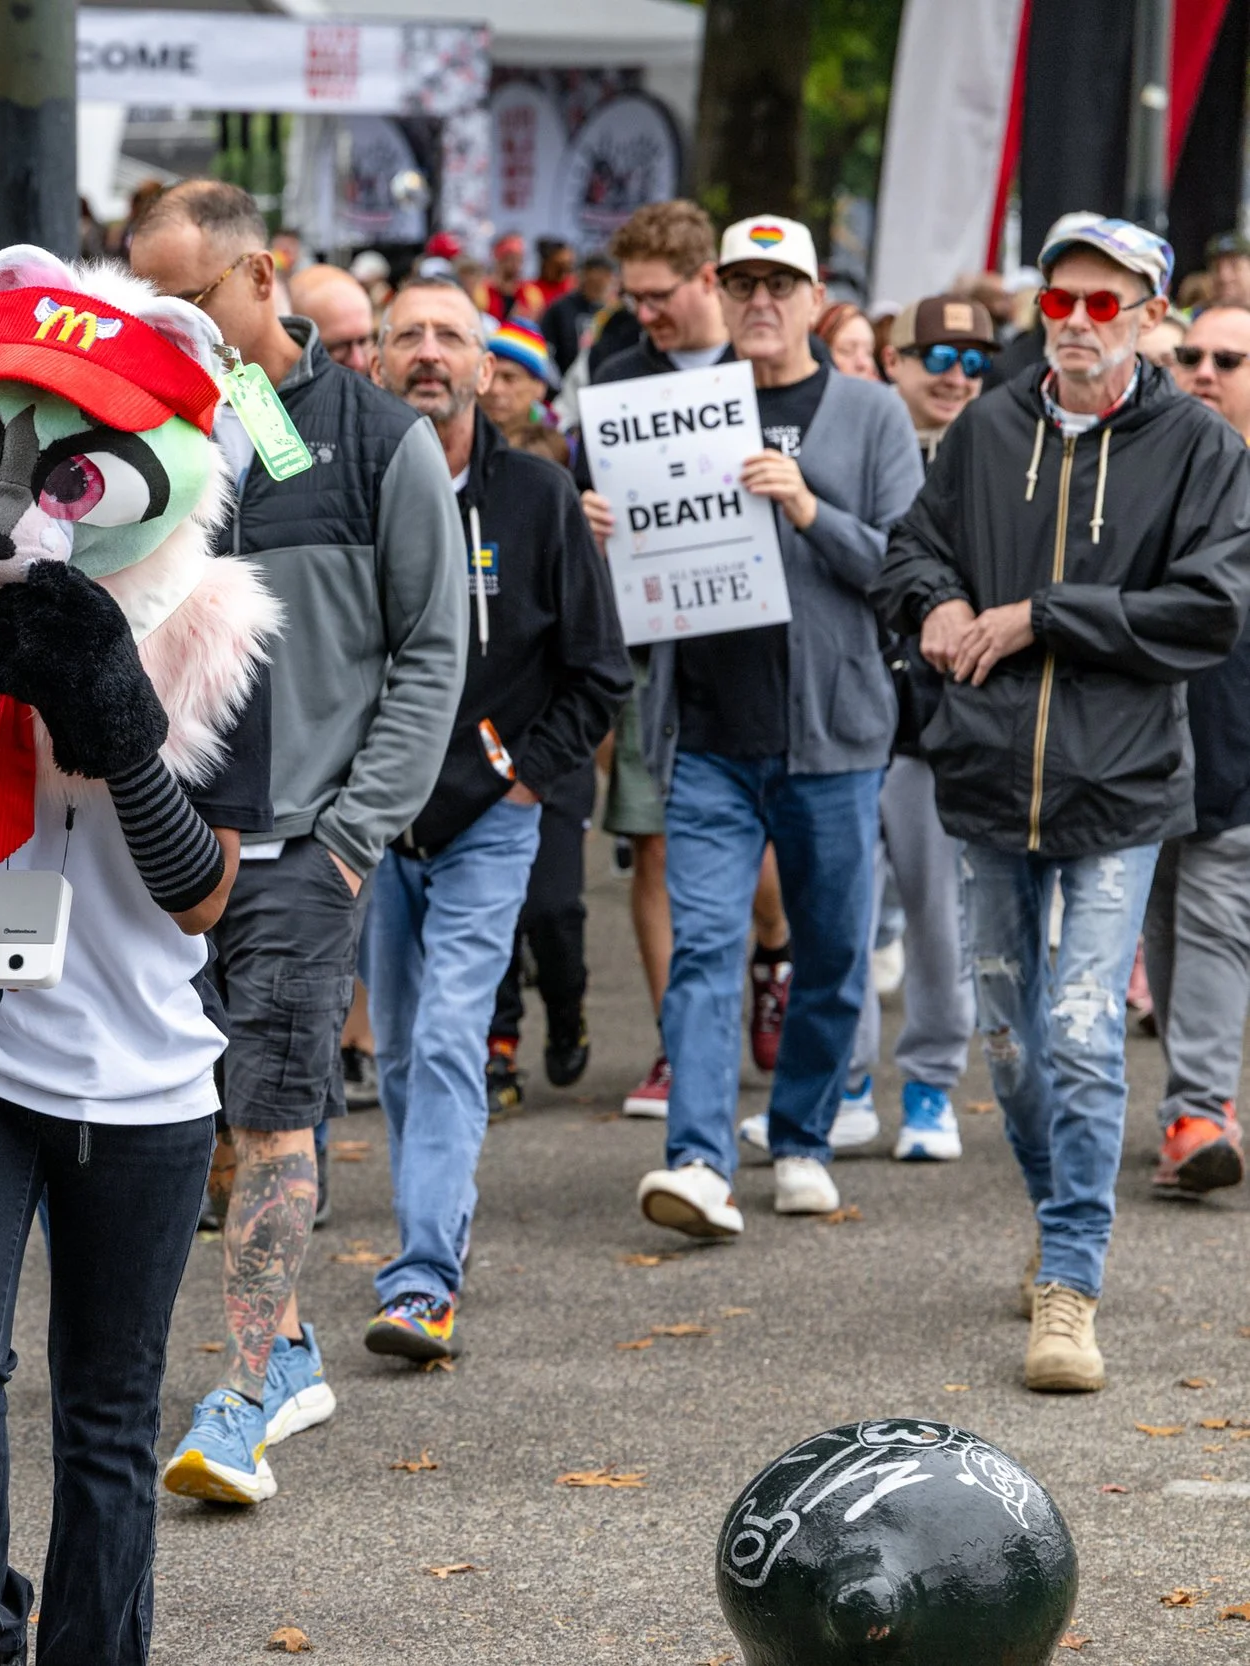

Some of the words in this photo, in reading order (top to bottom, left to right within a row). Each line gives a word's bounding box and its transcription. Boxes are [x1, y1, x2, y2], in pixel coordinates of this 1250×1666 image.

[599, 399, 744, 446] SILENCE
[628, 490, 743, 533] DEATH
[672, 572, 753, 610] LIFE
